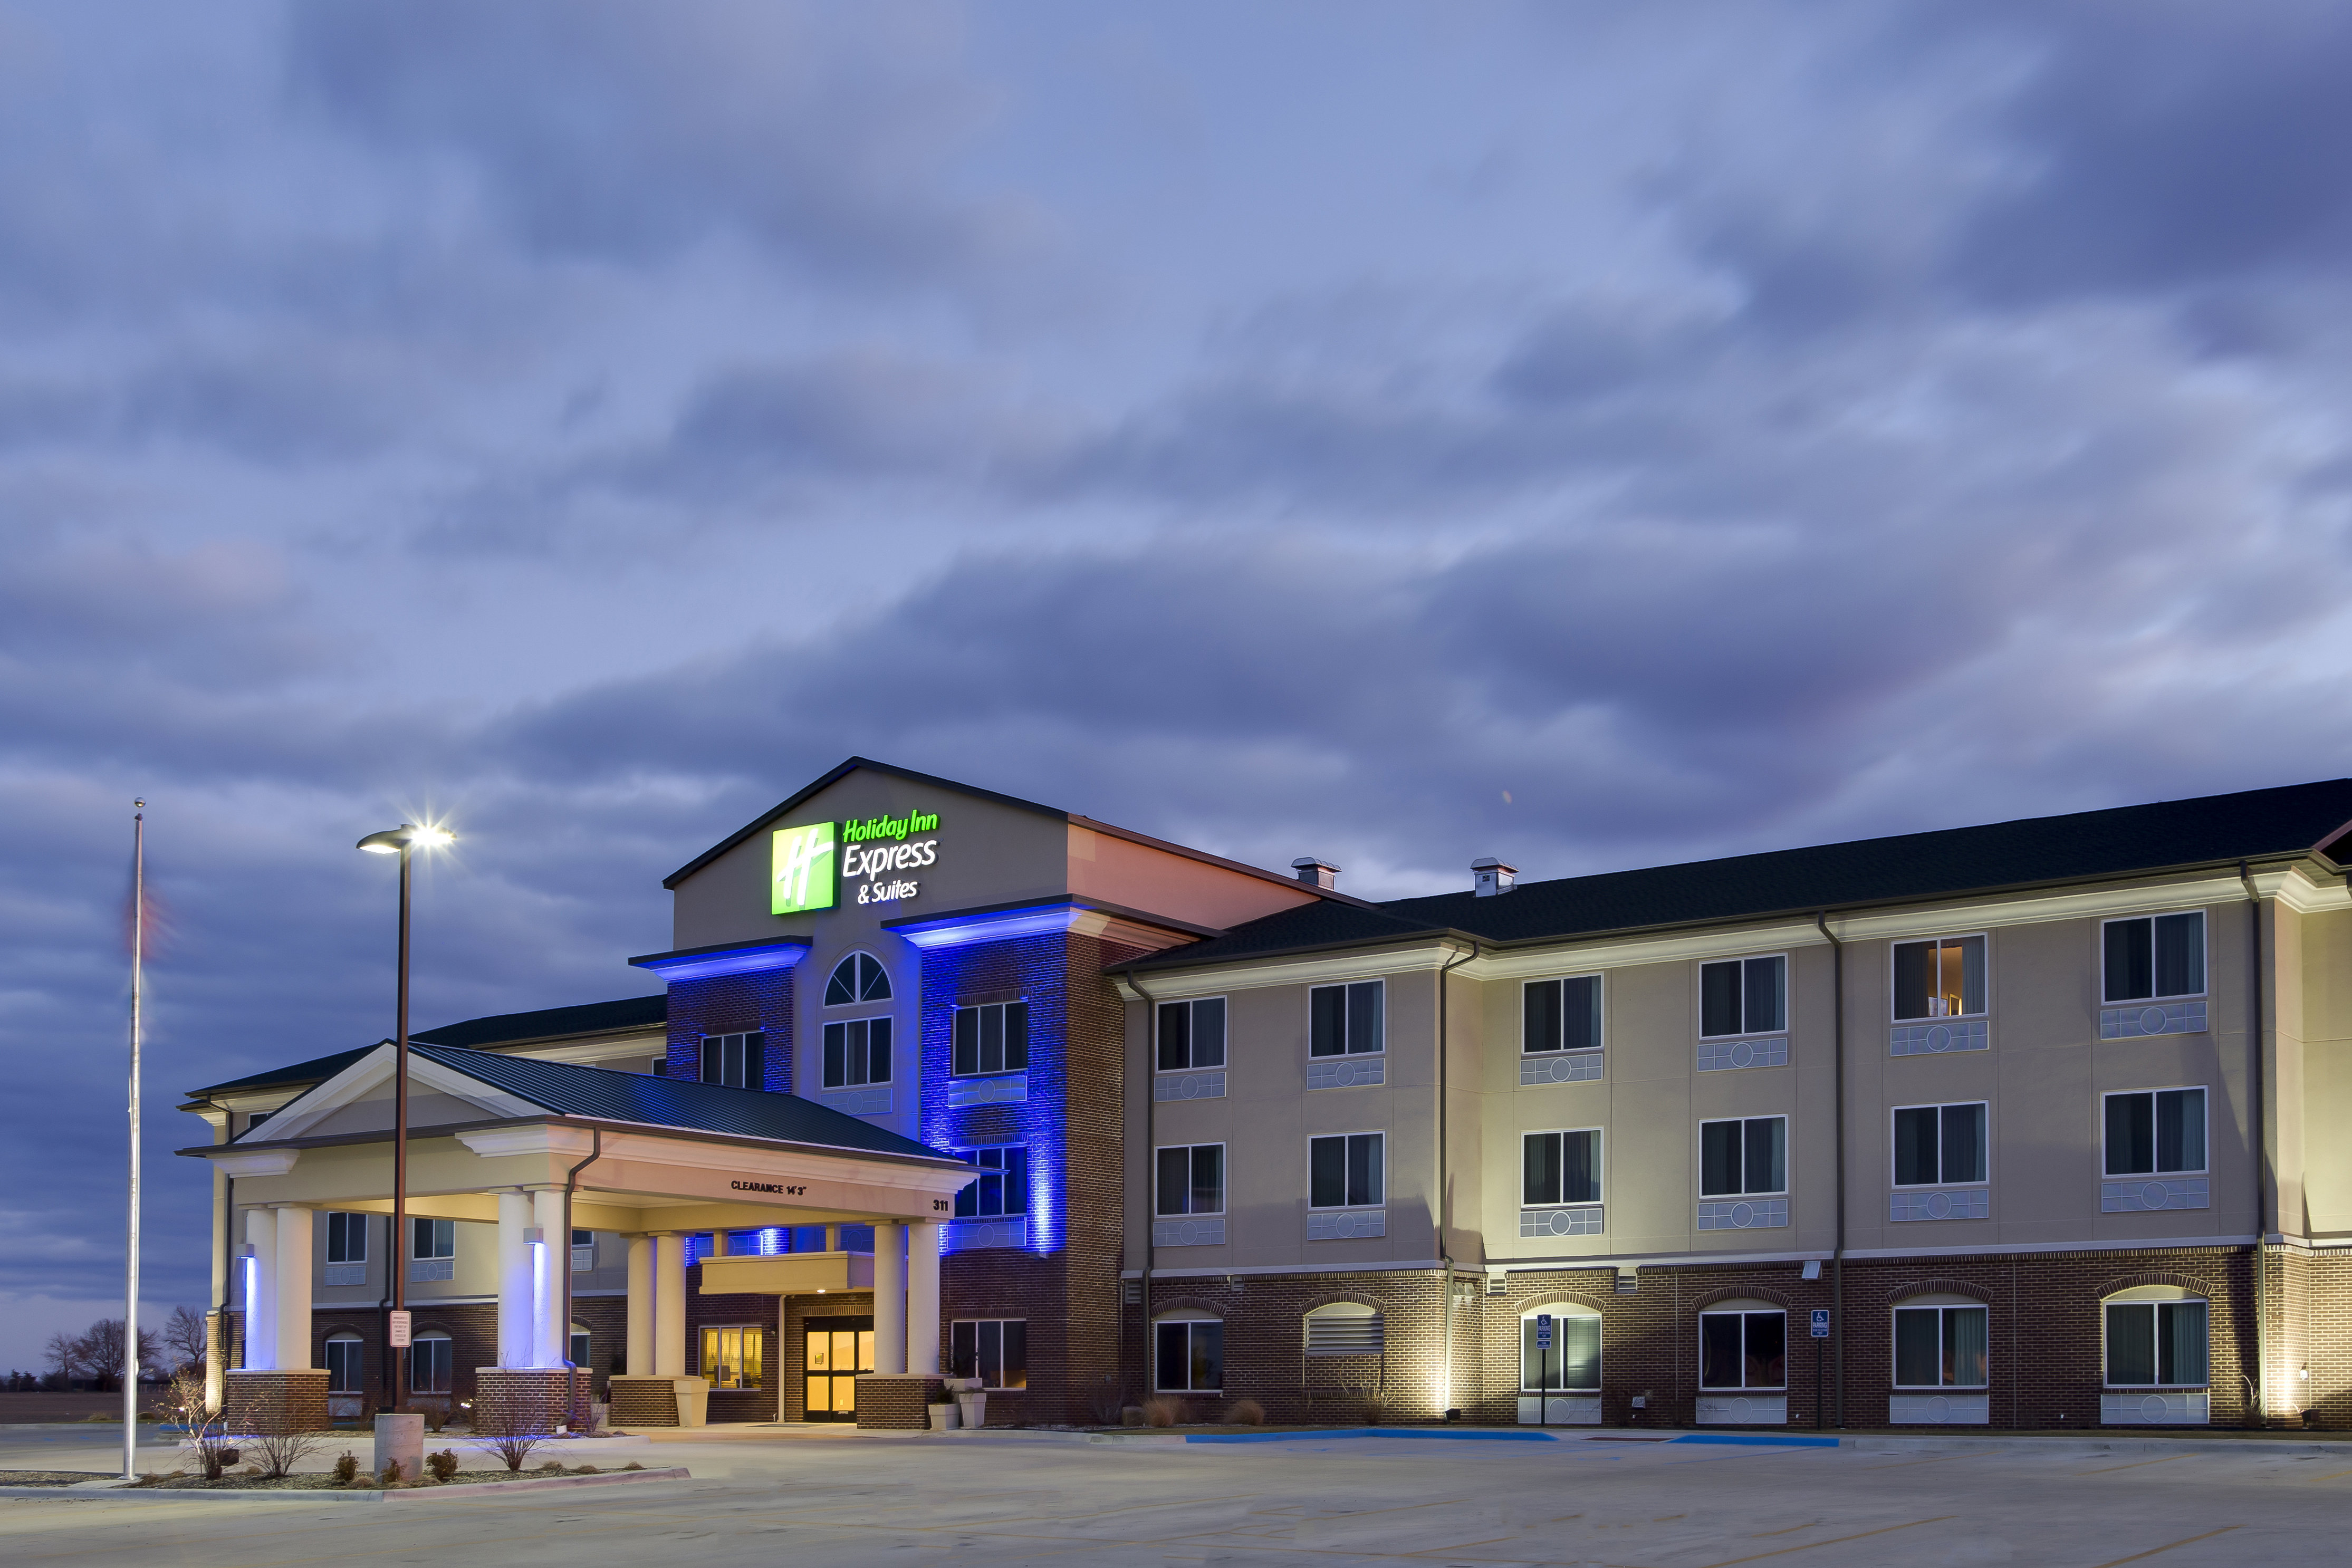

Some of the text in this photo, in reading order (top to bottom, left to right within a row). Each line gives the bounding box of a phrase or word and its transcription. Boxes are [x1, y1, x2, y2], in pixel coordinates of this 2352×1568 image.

[843, 809, 938, 843] Holiday Inn
[842, 840, 937, 881] Express
[857, 879, 918, 905] & Suites
[731, 1180, 784, 1194] CLEARANCE
[933, 1199, 949, 1211] 311
